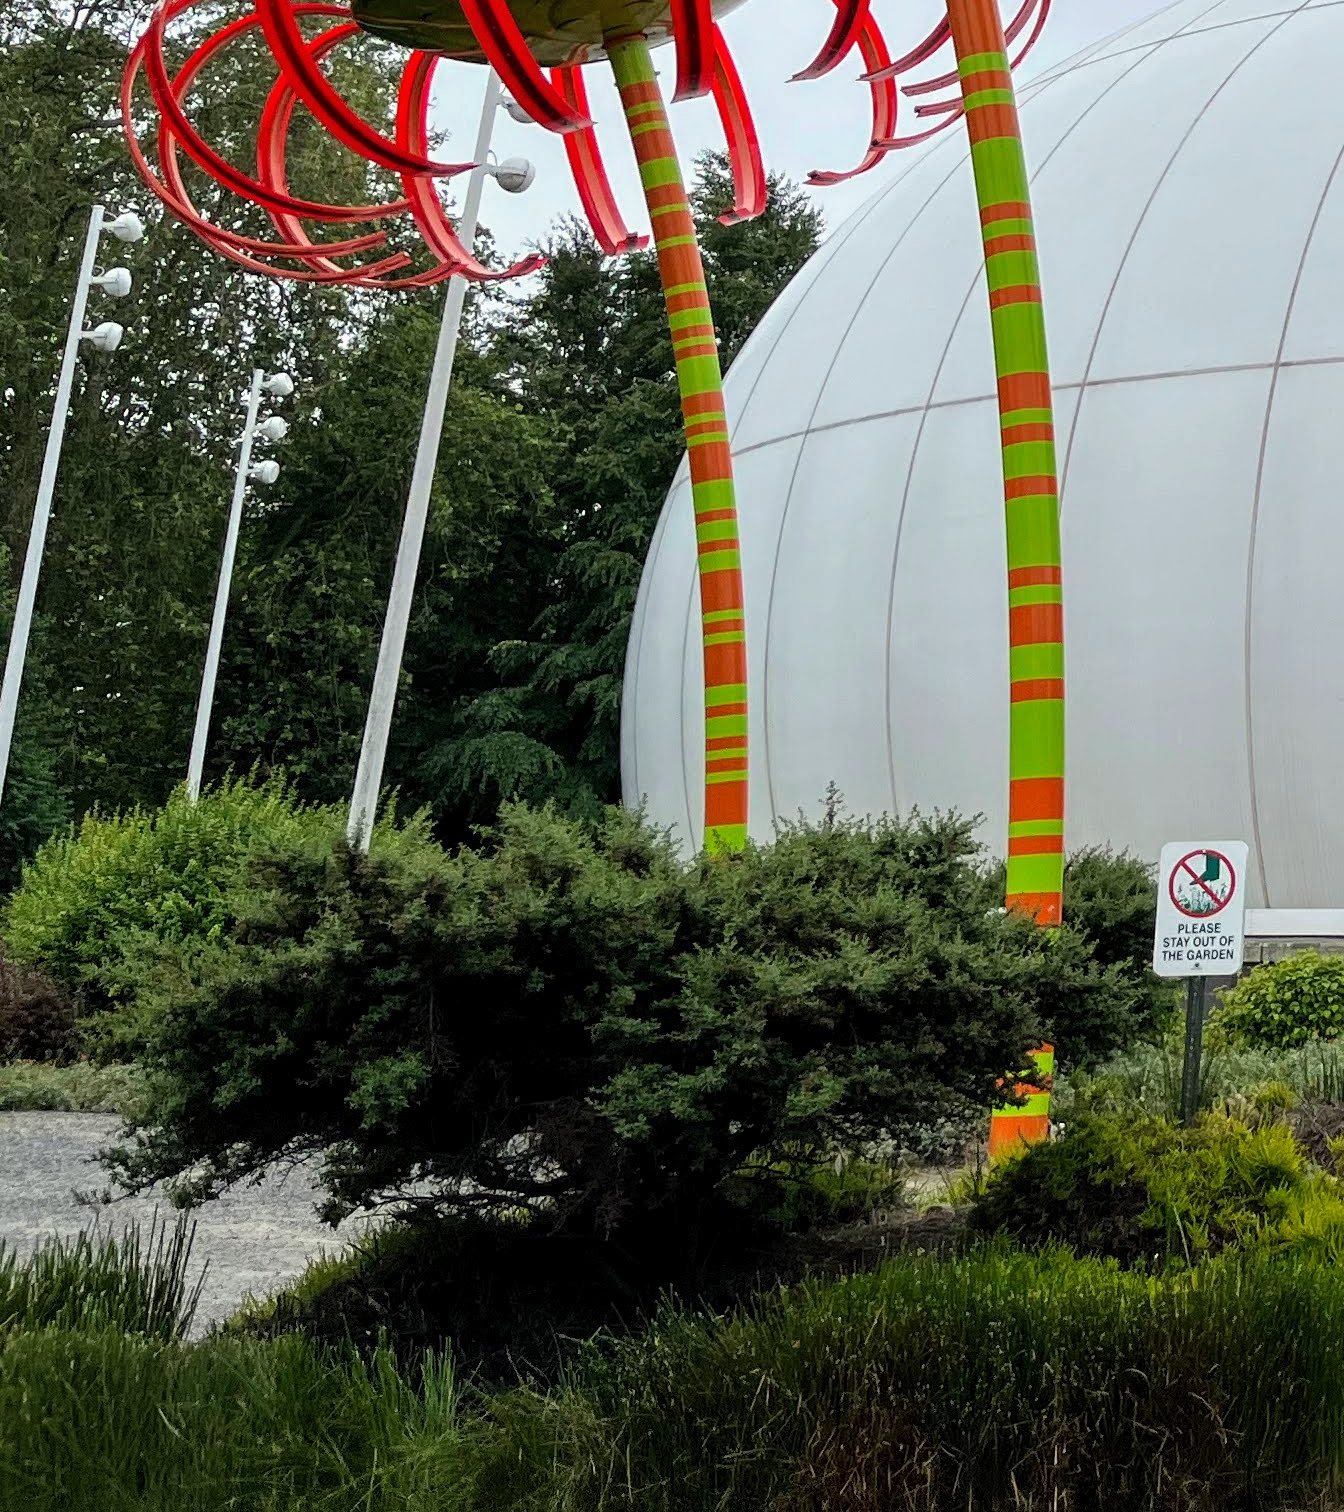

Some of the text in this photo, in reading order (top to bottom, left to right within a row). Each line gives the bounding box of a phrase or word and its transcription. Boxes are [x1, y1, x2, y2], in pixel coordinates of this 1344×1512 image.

[1178, 923, 1221, 934] PLEASE
[1163, 935, 1234, 948] STAY OUT OF
[1162, 949, 1234, 961] THE GARDEN
